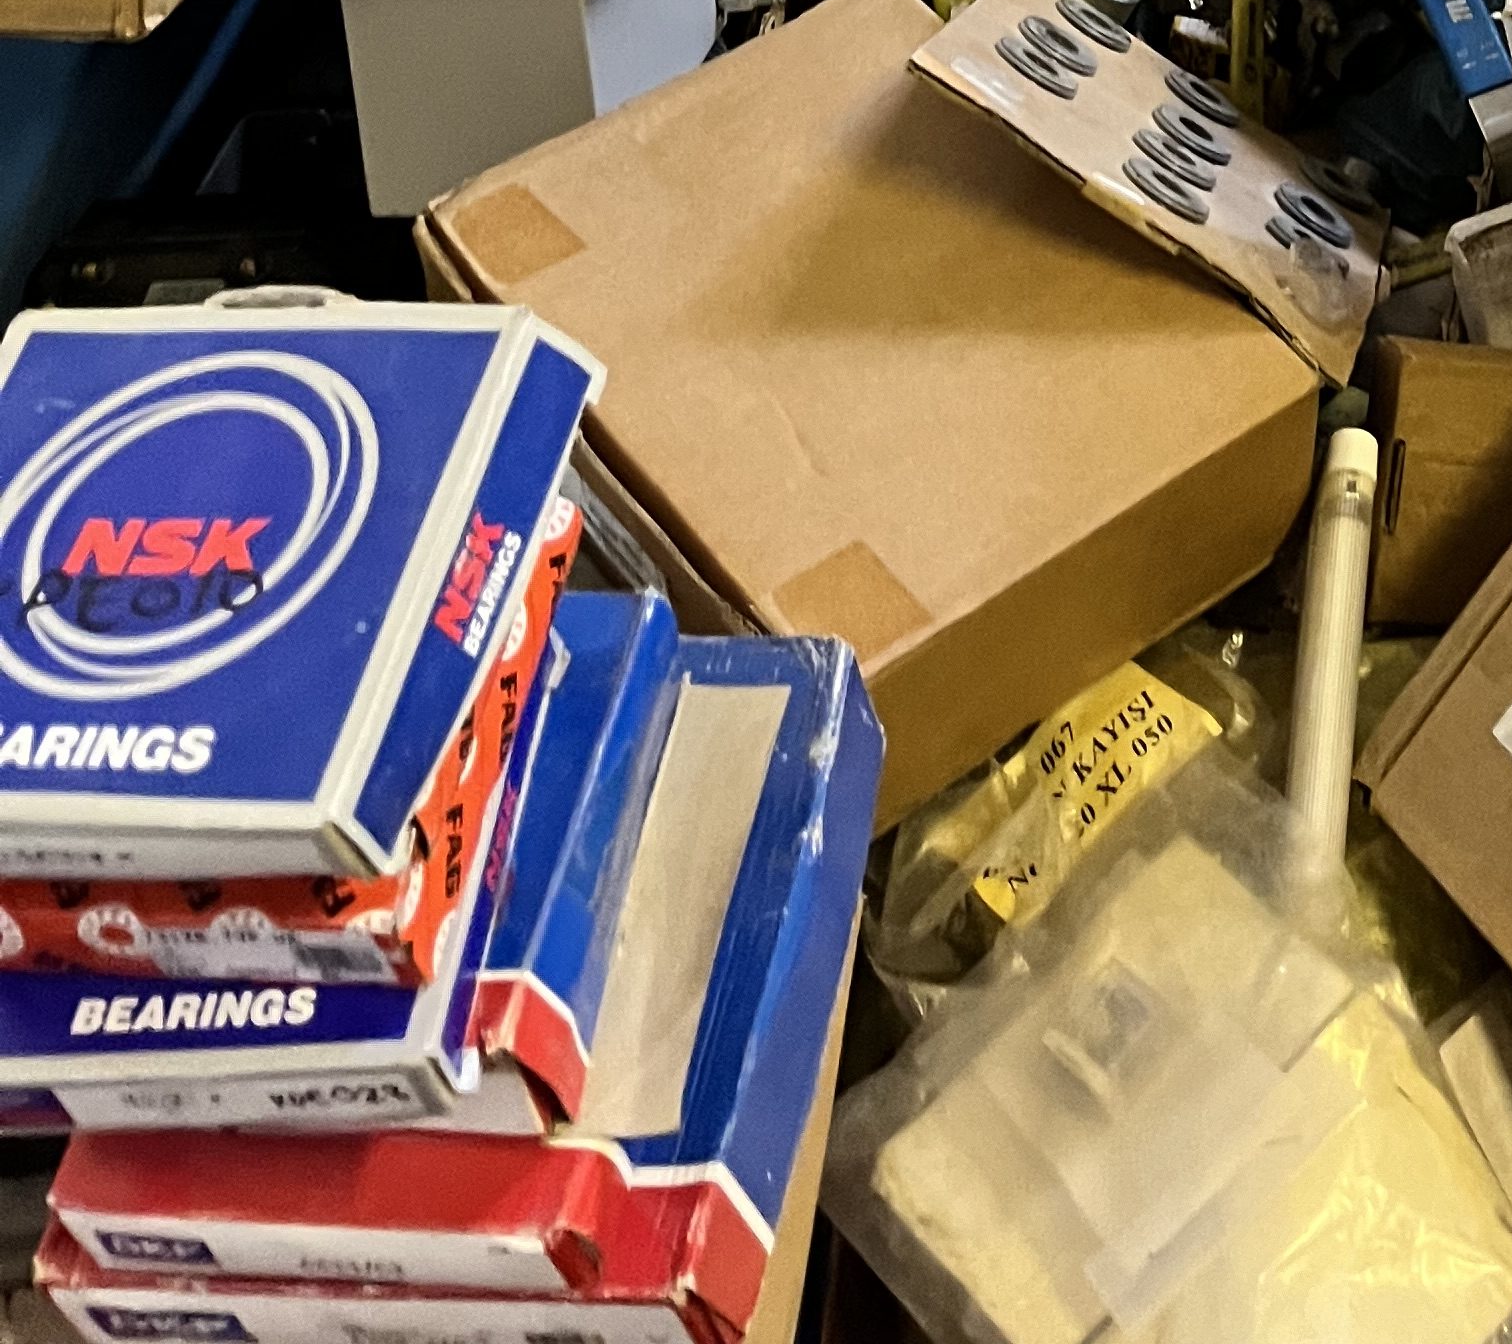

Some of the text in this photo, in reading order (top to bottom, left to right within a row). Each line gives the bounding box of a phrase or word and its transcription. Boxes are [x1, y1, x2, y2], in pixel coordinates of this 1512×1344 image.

[60, 516, 273, 578] NSK
[433, 511, 507, 648] NSK
[462, 528, 523, 660] BEARINGS
[1071, 690, 1155, 786] KAYIŞI
[1095, 759, 1133, 809] XL
[1131, 713, 1174, 758] 050
[444, 801, 465, 901] FAG
[69, 986, 318, 1037] BEARINGS
